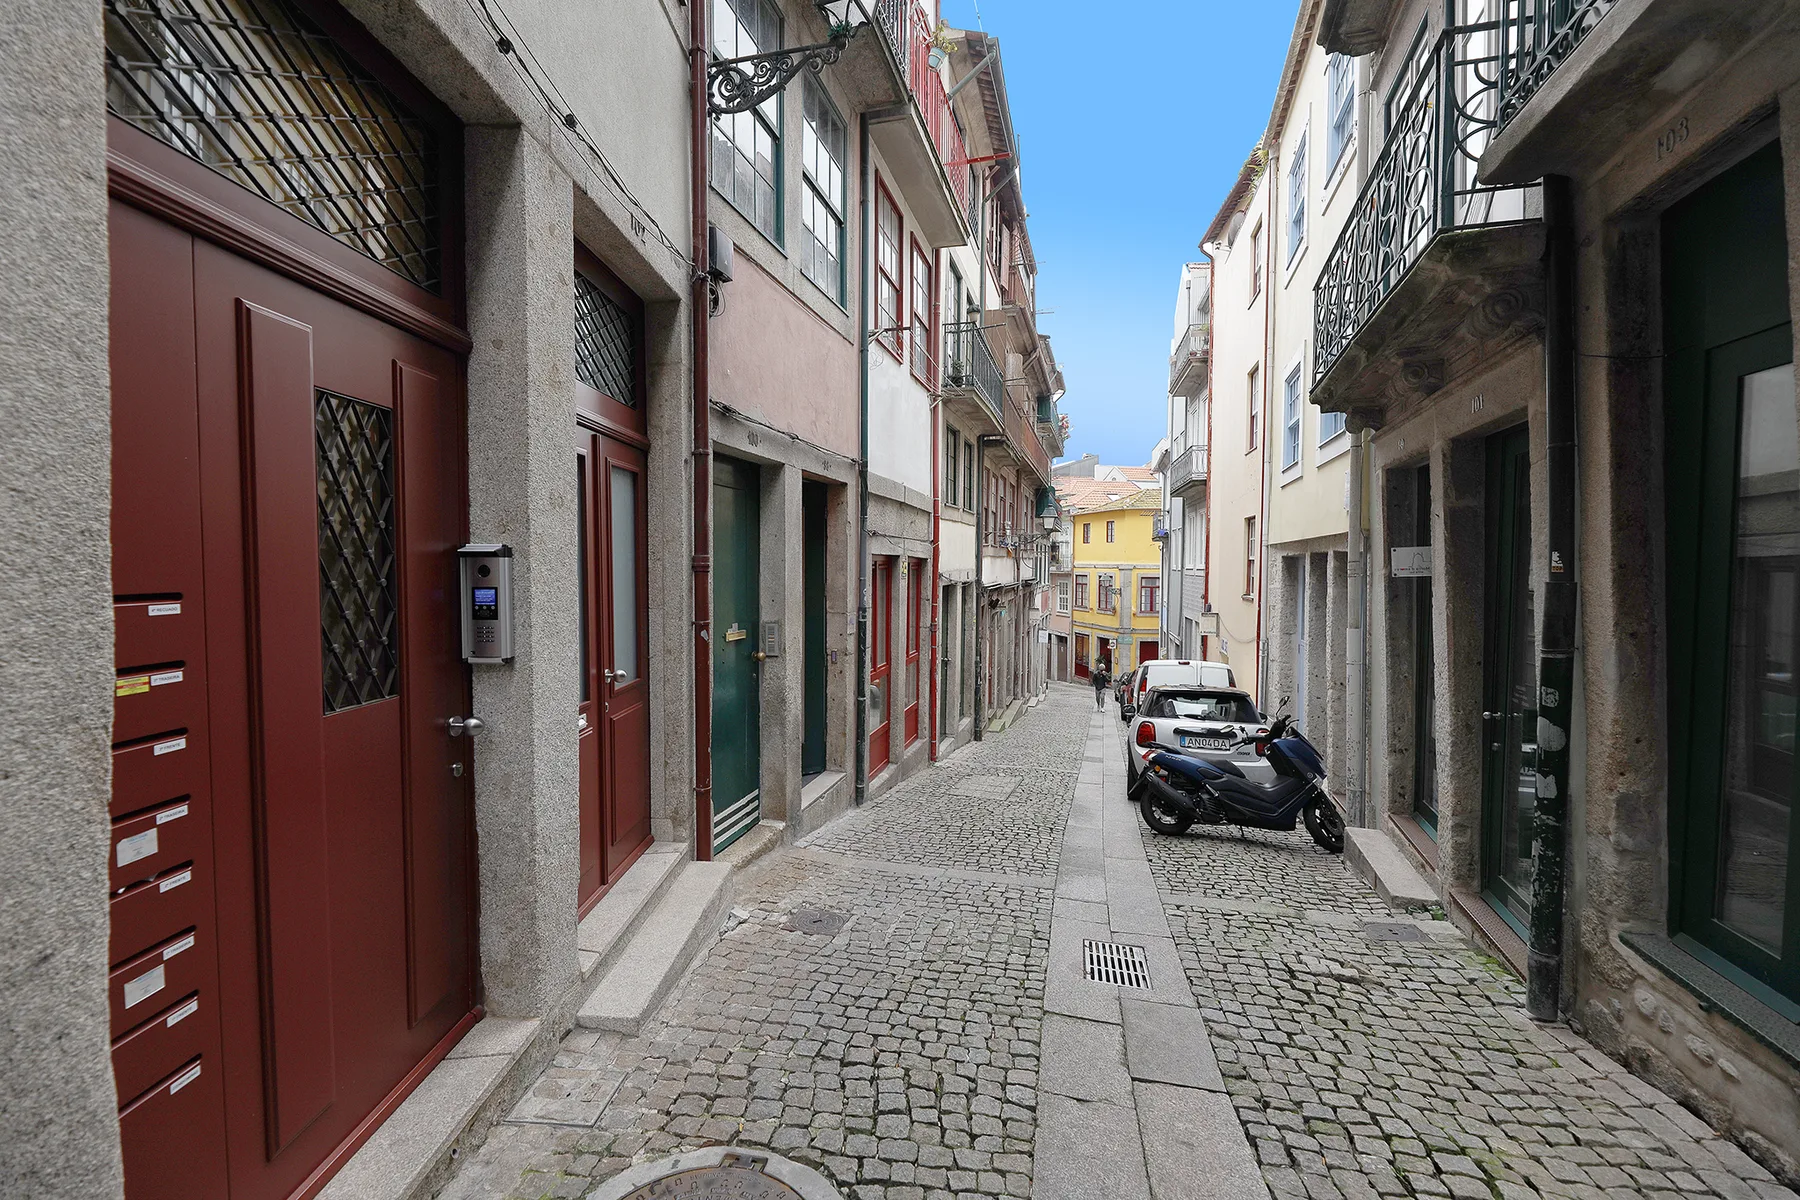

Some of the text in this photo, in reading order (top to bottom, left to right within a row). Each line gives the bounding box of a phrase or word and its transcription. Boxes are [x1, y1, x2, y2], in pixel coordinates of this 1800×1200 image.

[1656, 117, 1689, 163] 103
[1471, 393, 1484, 414] 101
[1187, 738, 1228, 748] AN04DA
